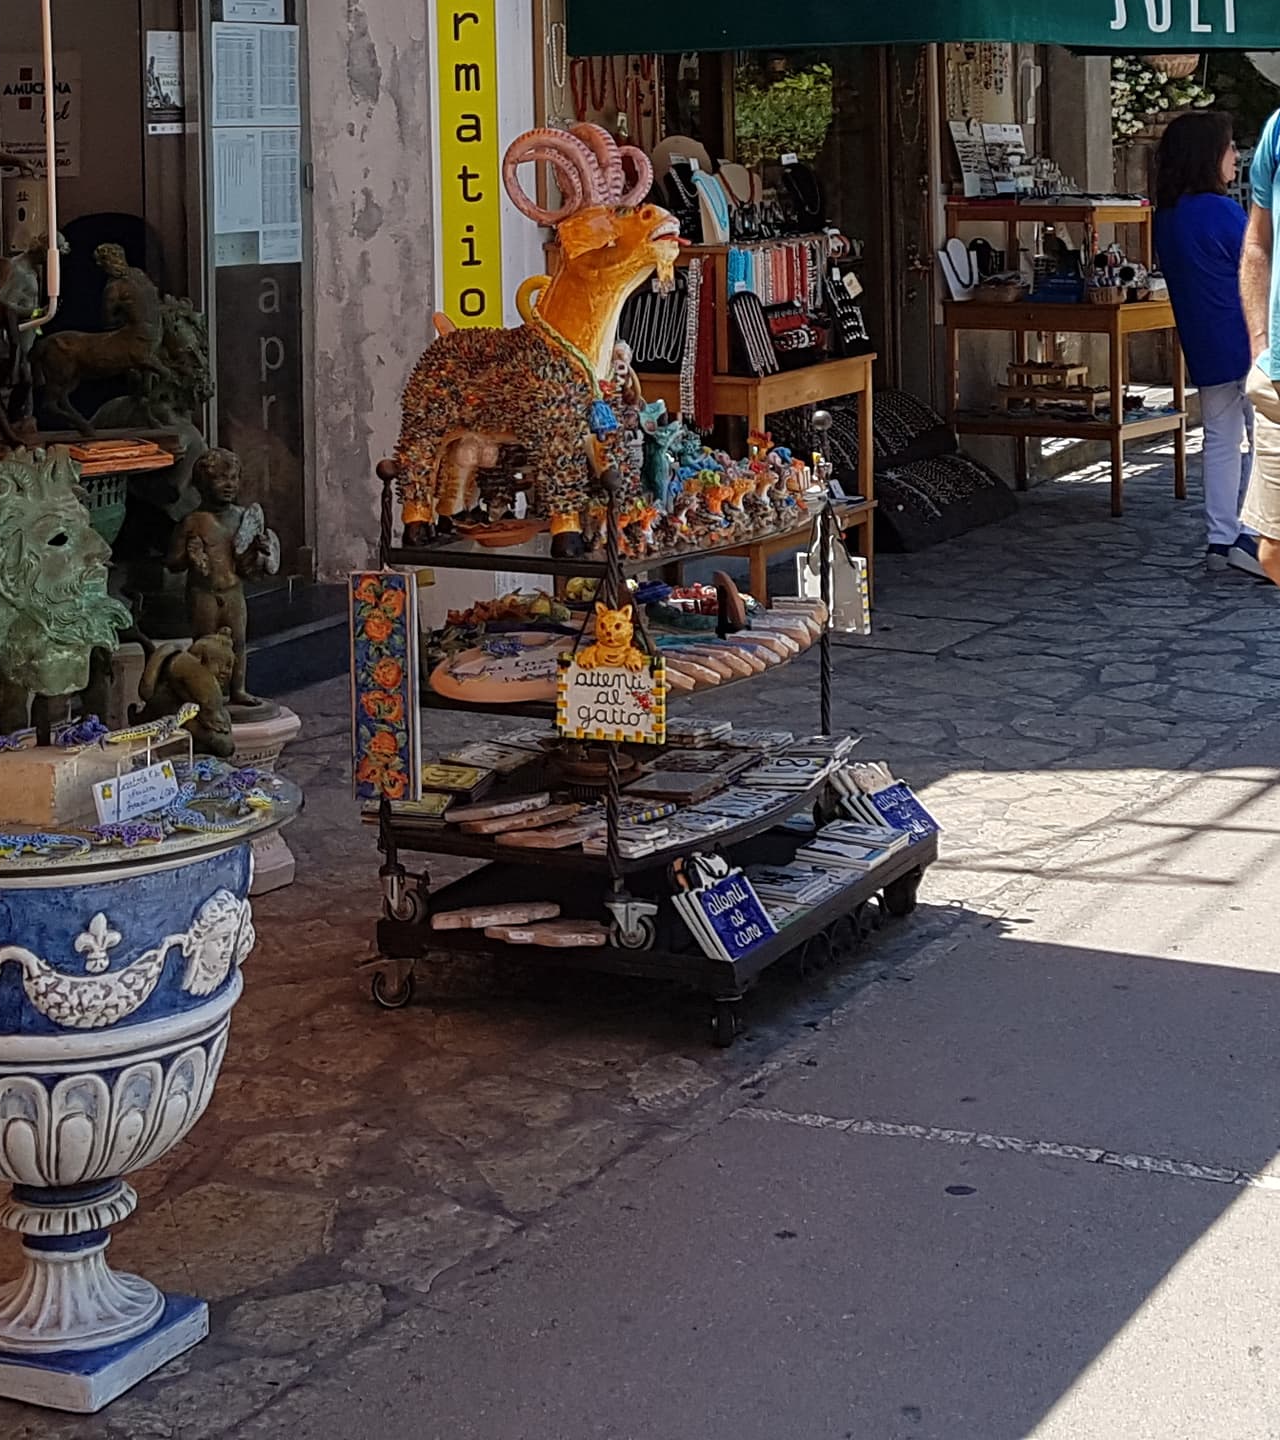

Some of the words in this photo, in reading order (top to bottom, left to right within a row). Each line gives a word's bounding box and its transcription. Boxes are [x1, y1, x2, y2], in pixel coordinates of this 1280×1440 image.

[2, 81, 72, 96] AMUCNA
[574, 671, 646, 690] attenti
[594, 689, 625, 706] al
[577, 706, 650, 729] gatto
[708, 882, 749, 916] attenti
[730, 908, 746, 928] al
